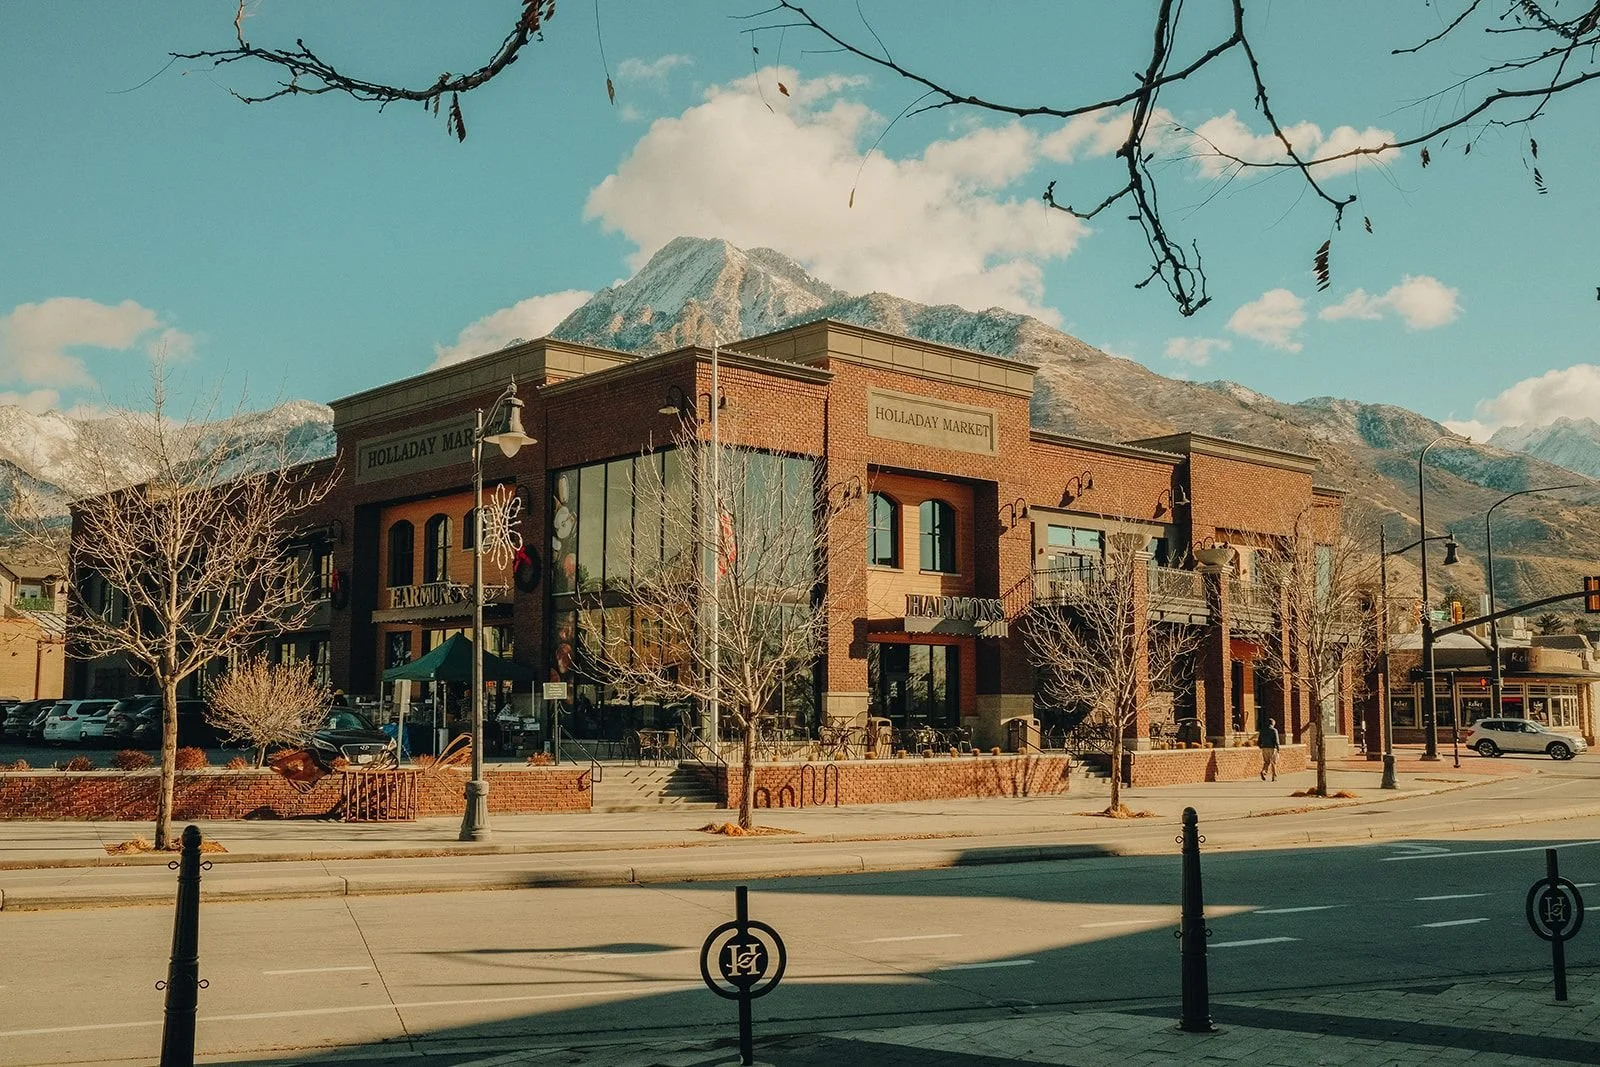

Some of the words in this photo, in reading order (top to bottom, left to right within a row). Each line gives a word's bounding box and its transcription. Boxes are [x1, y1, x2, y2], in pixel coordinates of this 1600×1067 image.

[875, 406, 939, 429] HOLLADAY
[943, 418, 990, 438] MARKET
[367, 436, 437, 469] HOLLADAY
[904, 593, 1005, 622] HARMONS
